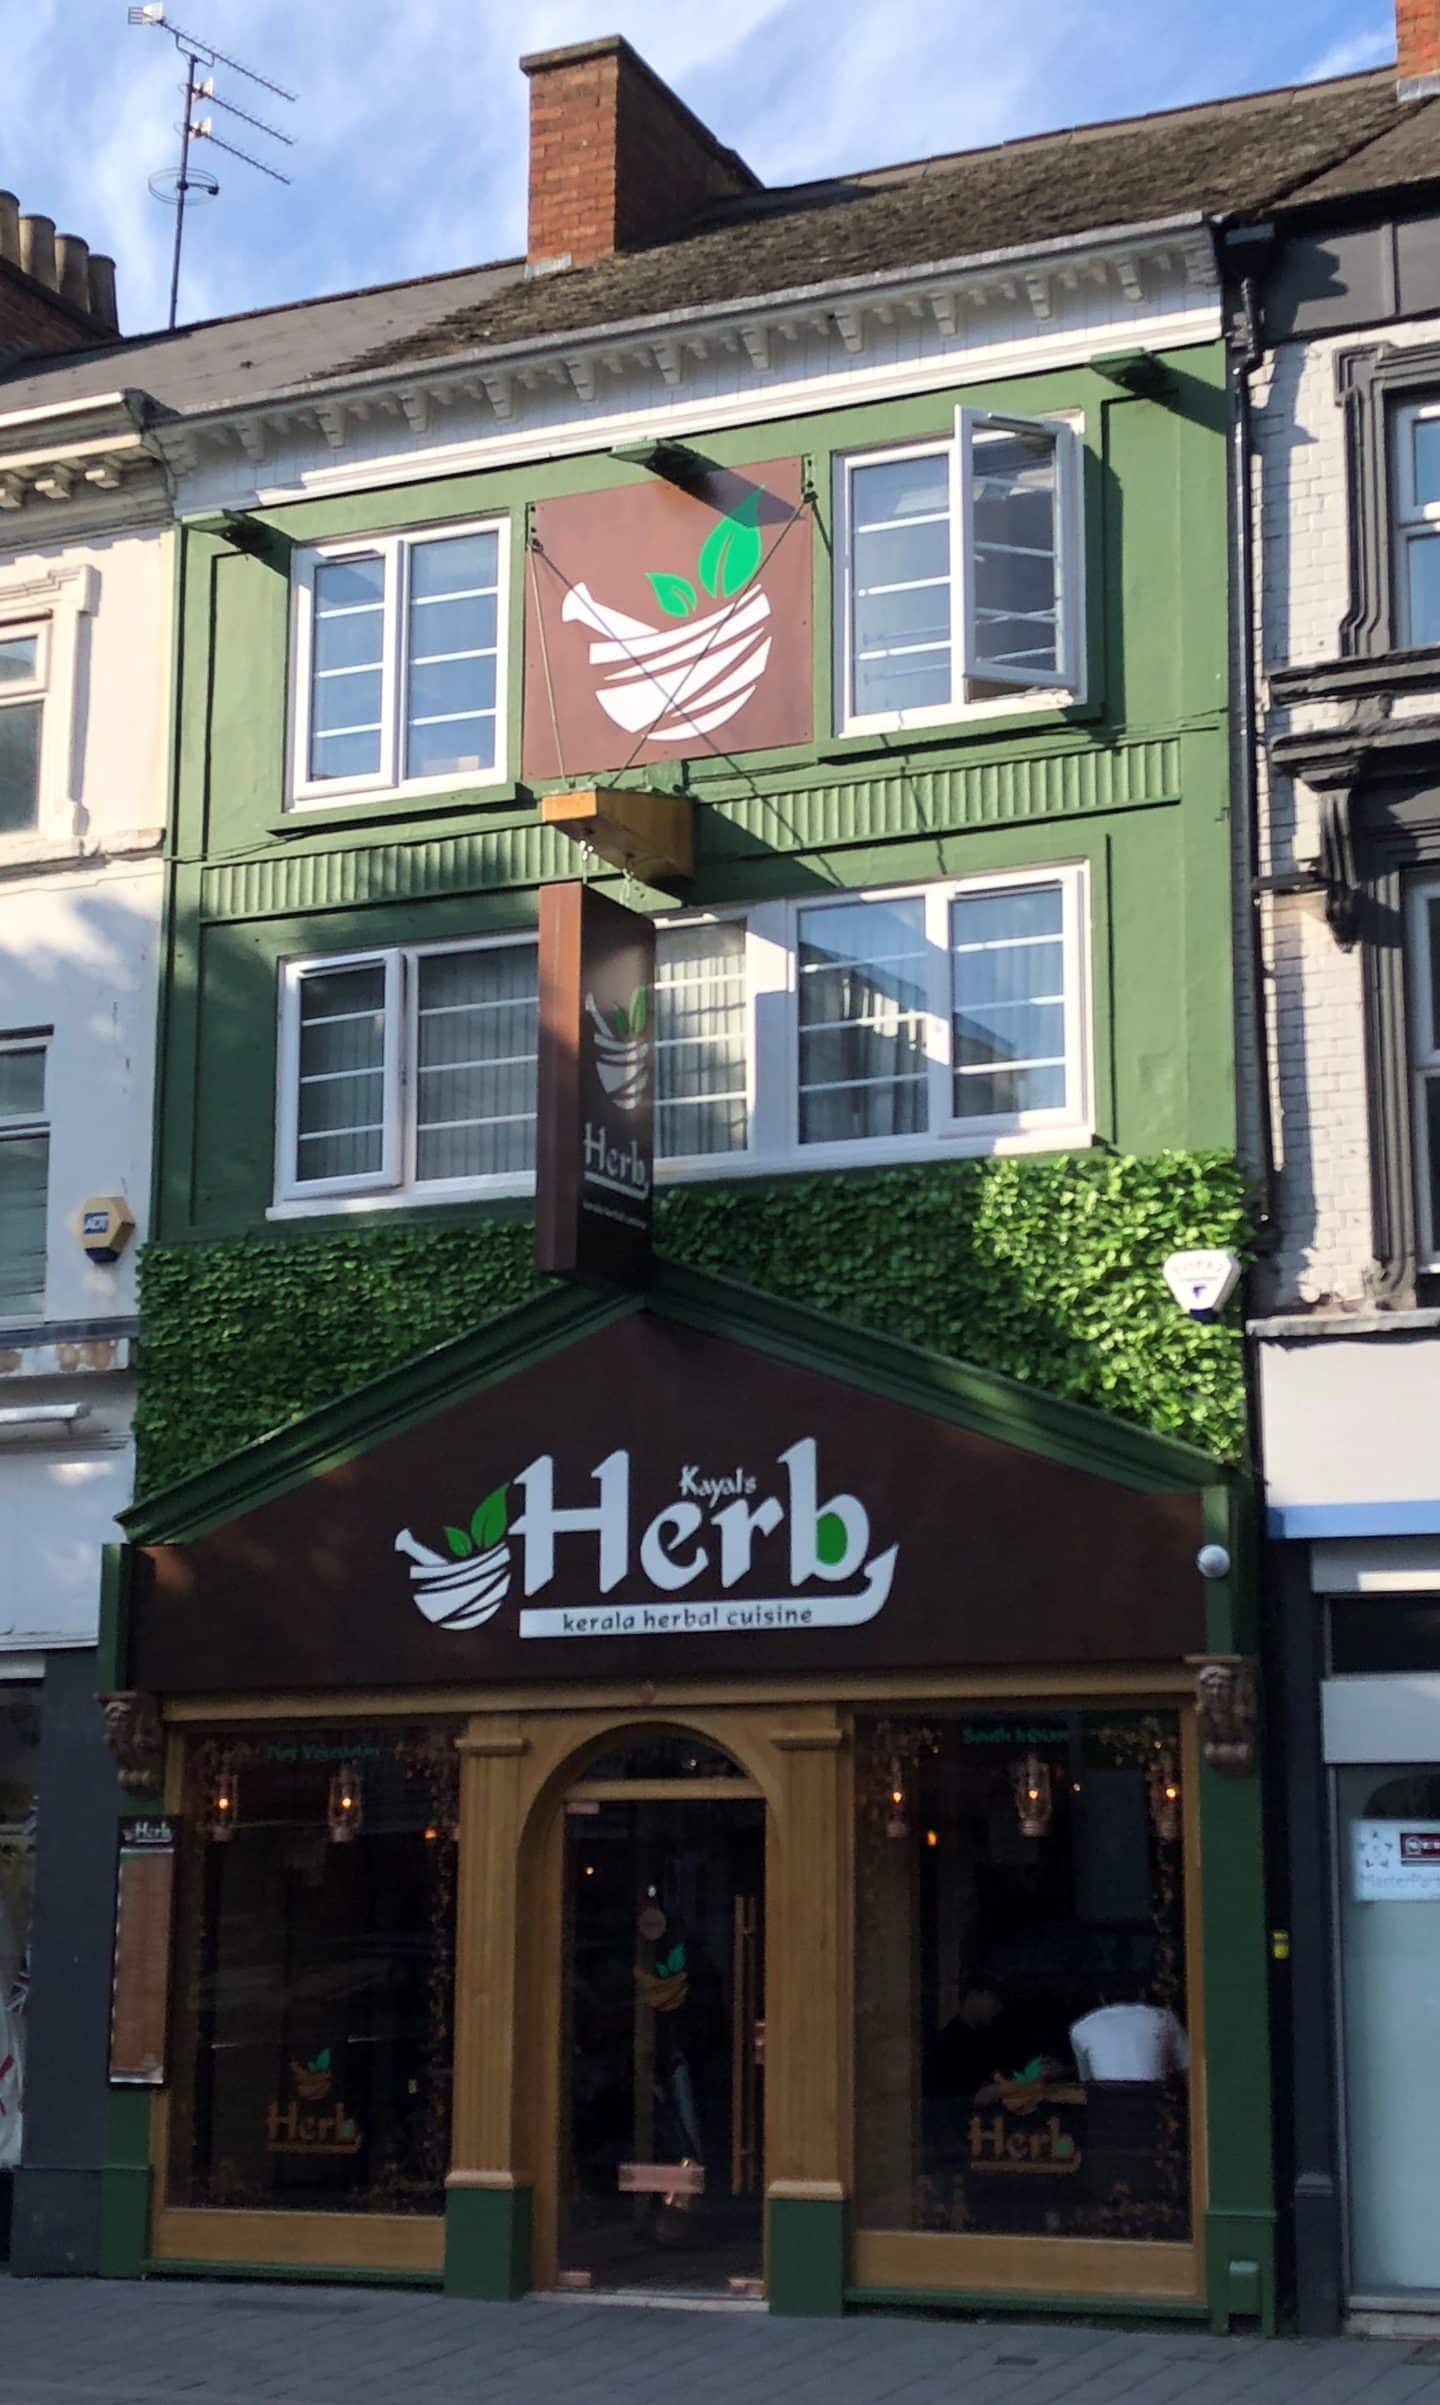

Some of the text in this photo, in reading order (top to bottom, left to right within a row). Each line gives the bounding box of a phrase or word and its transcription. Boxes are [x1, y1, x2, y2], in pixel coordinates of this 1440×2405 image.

[583, 1122, 645, 1185] Herb
[678, 1465, 757, 1507] Kayals
[508, 1437, 870, 1596] Herb
[562, 1606, 813, 1633] kerala herbal cuisine
[265, 2097, 356, 2141] Herb
[967, 2114, 1073, 2159] Herb
